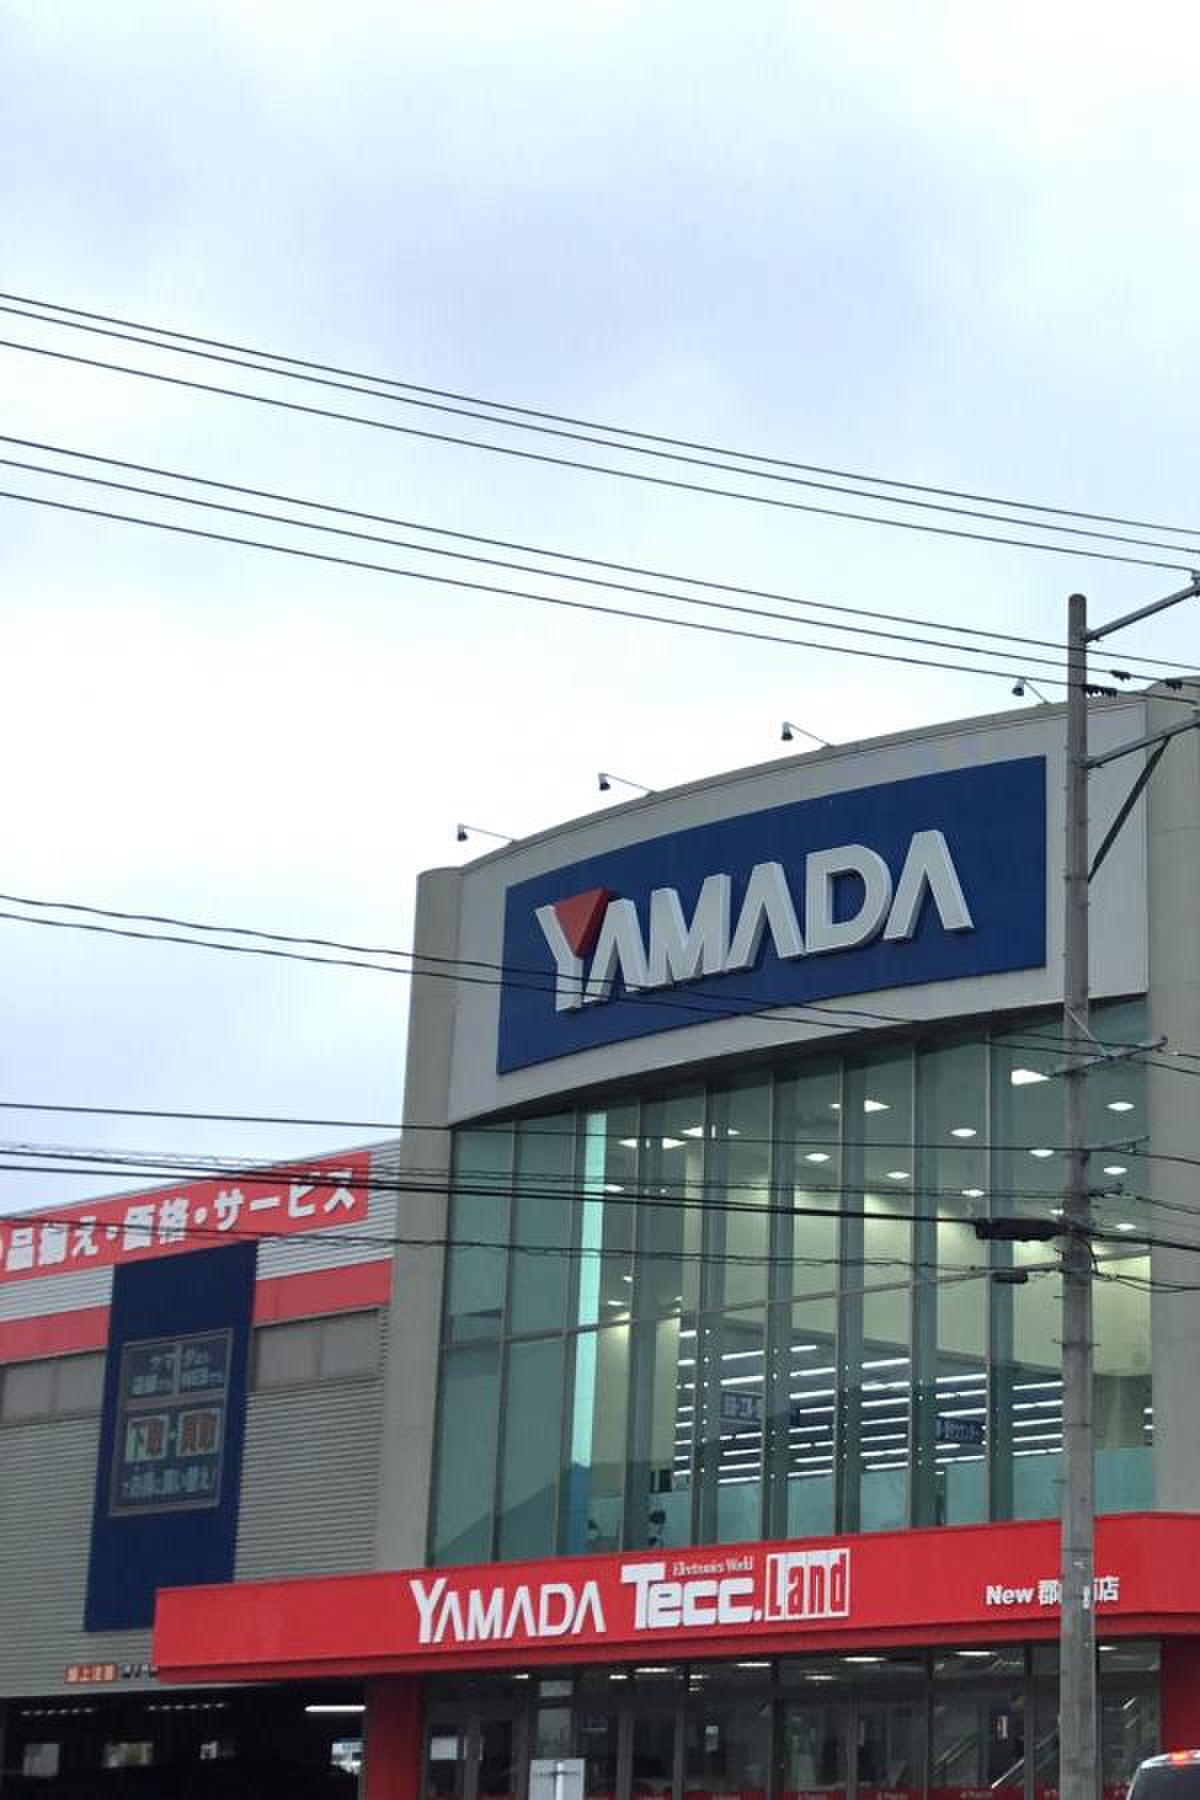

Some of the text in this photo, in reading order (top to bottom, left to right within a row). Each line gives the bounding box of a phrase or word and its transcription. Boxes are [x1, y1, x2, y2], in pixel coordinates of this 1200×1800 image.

[534, 828, 975, 1013] YAMADA
[0, 1168, 357, 1272] 品揃え・価格・サービス
[408, 1577, 606, 1644] YAMADA
[767, 1550, 848, 1618] Land
[985, 1584, 1034, 1606] New
